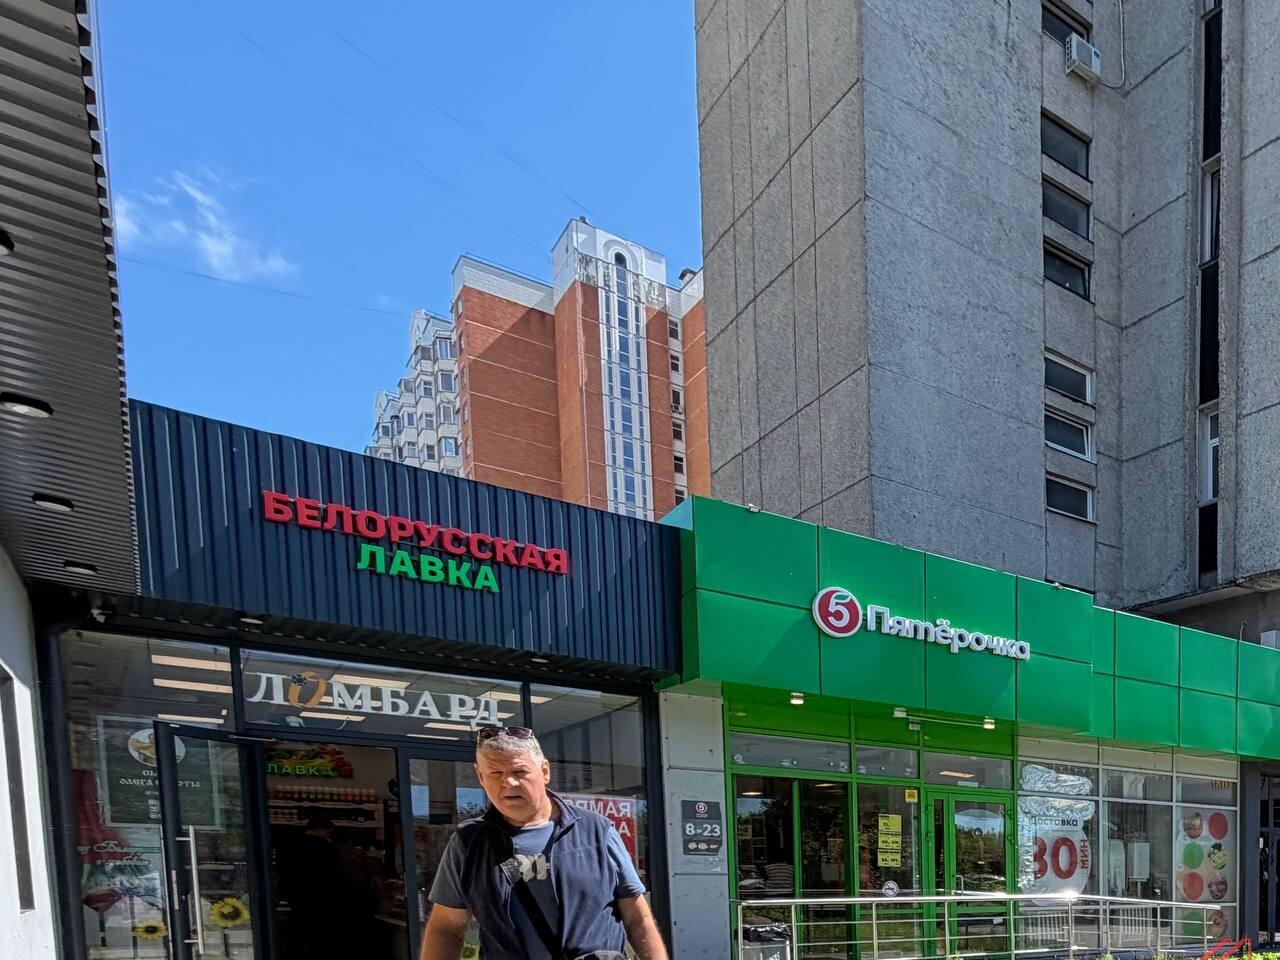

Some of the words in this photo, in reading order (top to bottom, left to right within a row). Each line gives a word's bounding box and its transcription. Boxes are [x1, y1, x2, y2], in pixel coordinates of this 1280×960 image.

[263, 490, 568, 575] БЕЛОРУССКАЯ
[357, 543, 500, 593] ЛАВКА
[867, 604, 1031, 660] Пятёрочка
[247, 671, 504, 731] ЛОМБАРД
[685, 822, 721, 837] 8-23
[1033, 836, 1079, 880] 30
